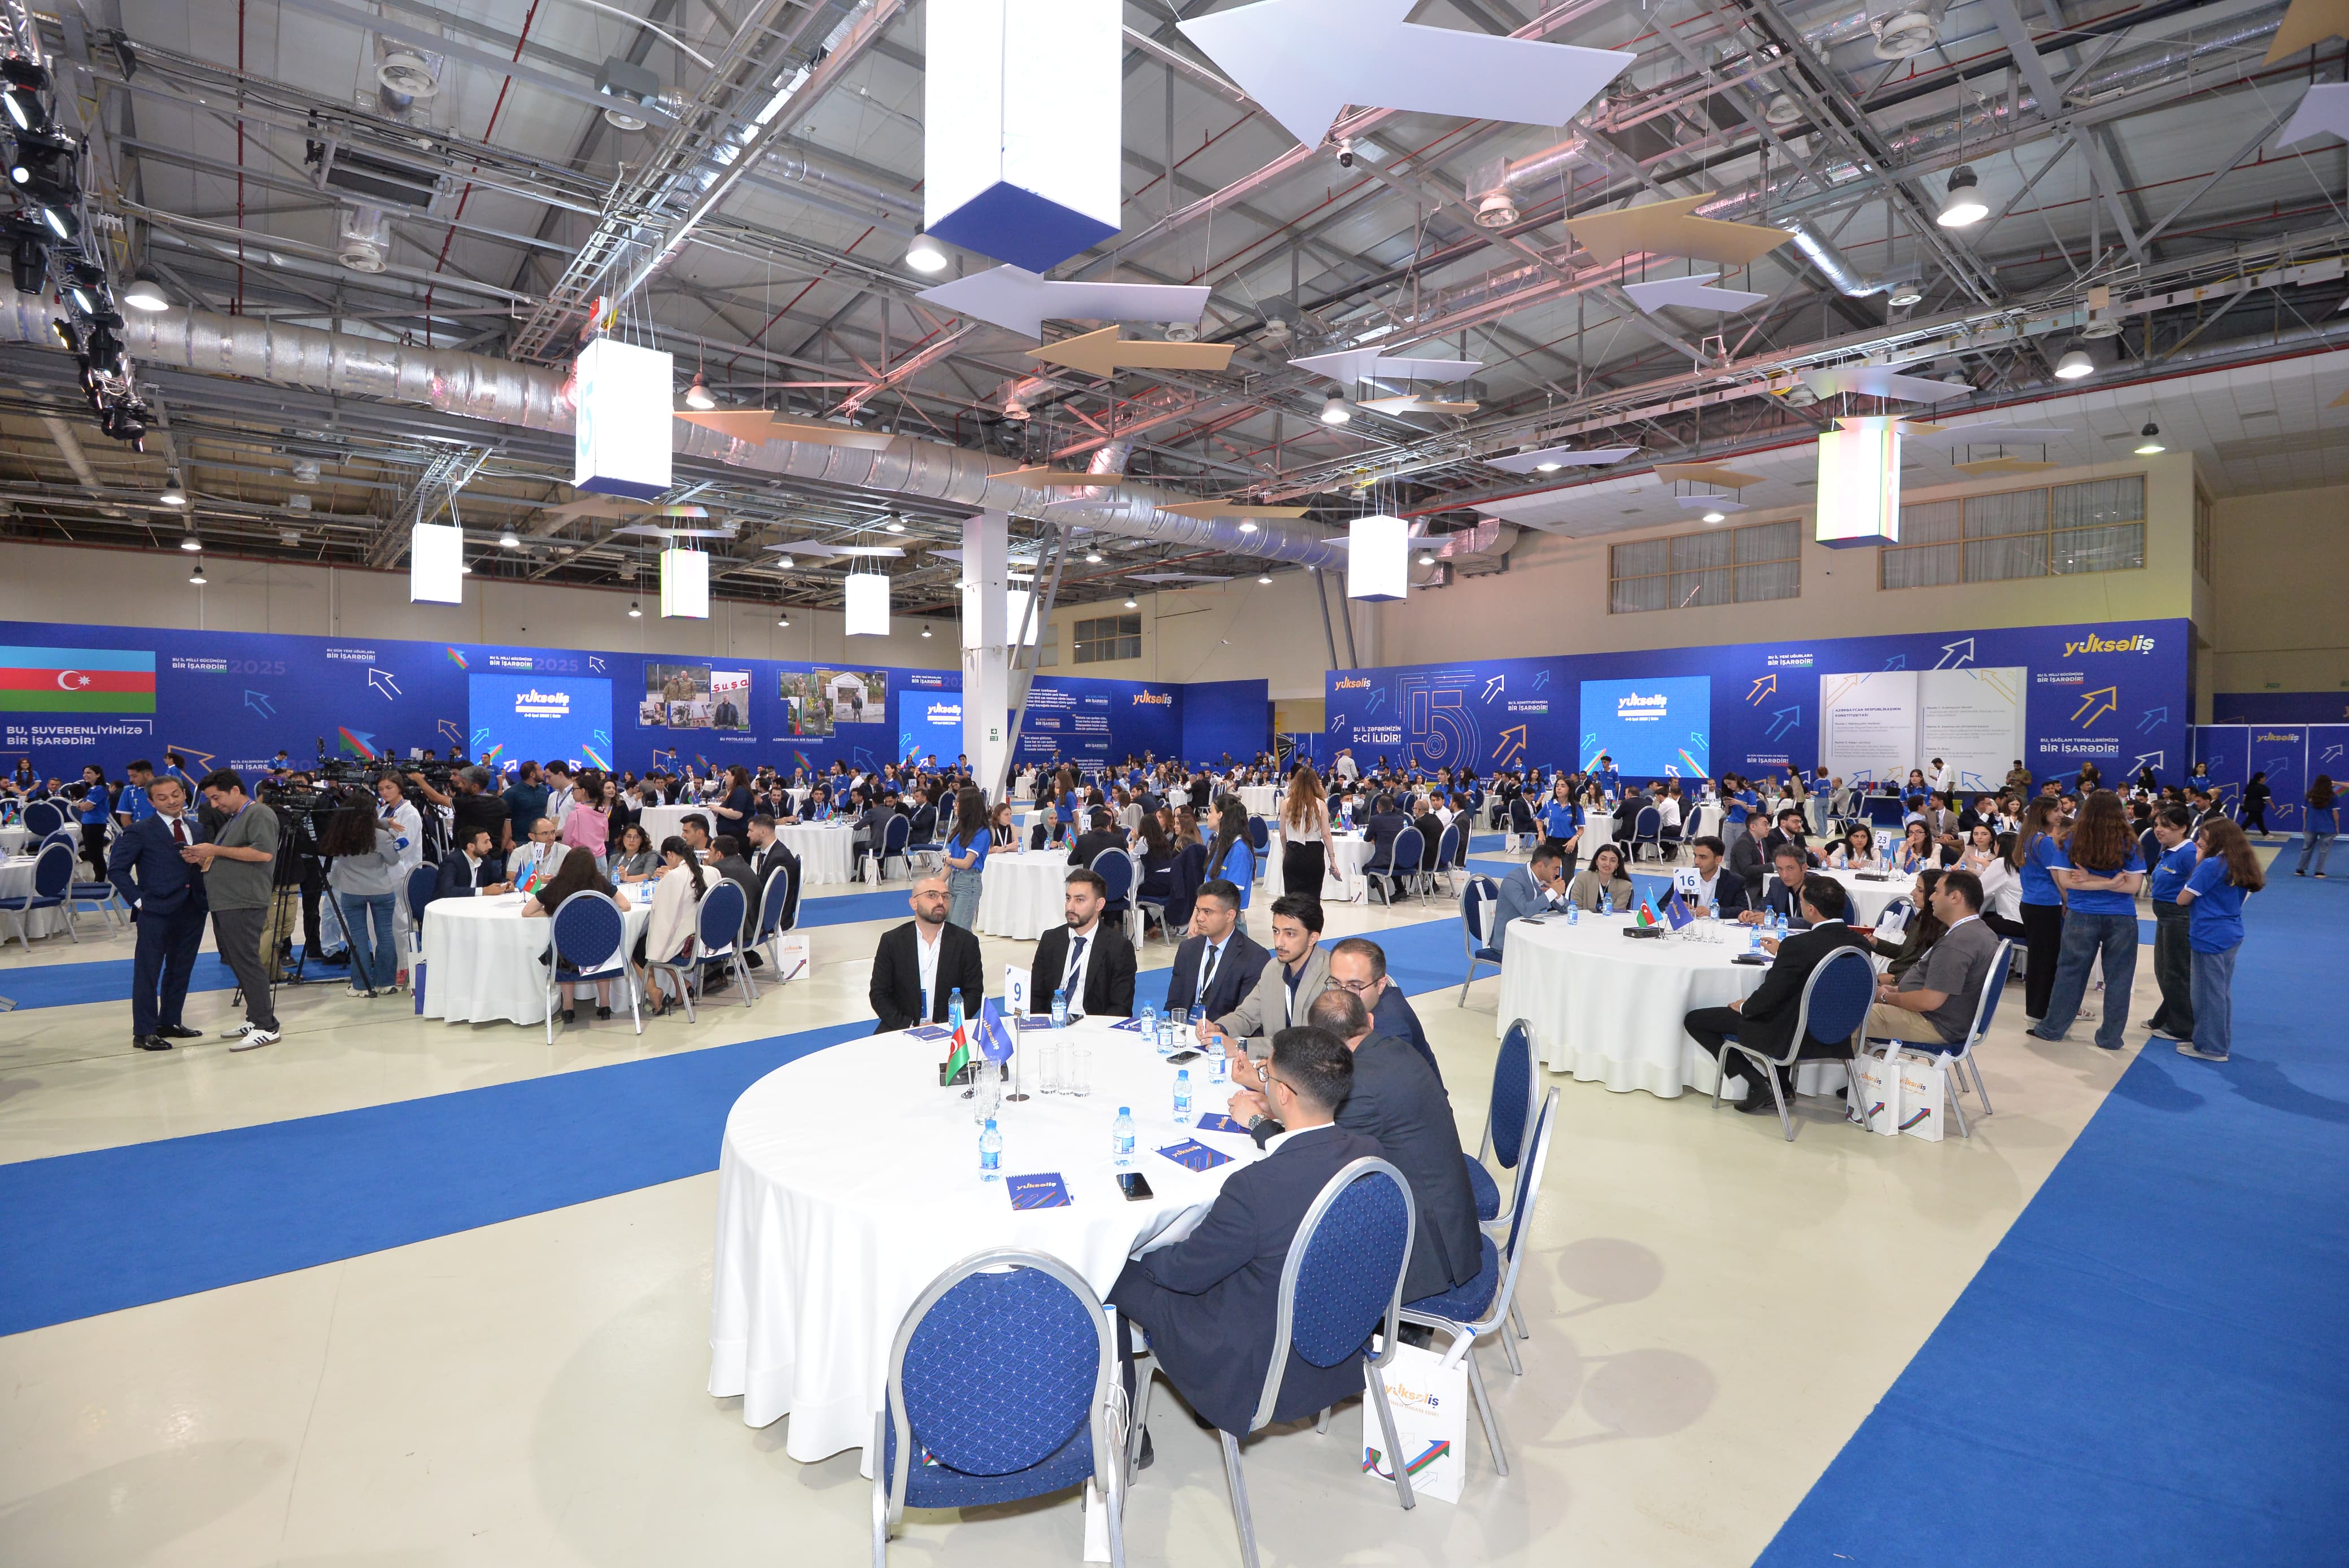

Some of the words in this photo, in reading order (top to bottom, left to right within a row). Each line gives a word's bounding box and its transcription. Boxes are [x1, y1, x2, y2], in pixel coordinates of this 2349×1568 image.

[2063, 633, 2155, 657] yüksəliş
[229, 659, 285, 674] 2025
[535, 658, 578, 671] 2025
[1335, 676, 1371, 691] yüksəliş
[1133, 689, 1172, 707] yüksəliş
[7, 727, 28, 735] BU,
[32, 726, 143, 735] SUVERENLİYİMİZƏ
[7, 736, 29, 745] BİR
[32, 736, 95, 746] İŞARƏDİR!
[1353, 732, 1370, 742] 5-Cİ
[1373, 732, 1401, 742] İLİDİR!
[2256, 732, 2299, 743] yüksəliş
[2040, 744, 2058, 752] BİR
[2062, 744, 2119, 753] İŞARƏDİR!
[1878, 836, 1887, 844] 23
[536, 849, 542, 858] 10
[1679, 875, 1695, 886] 16
[1014, 982, 1021, 1002] 9
